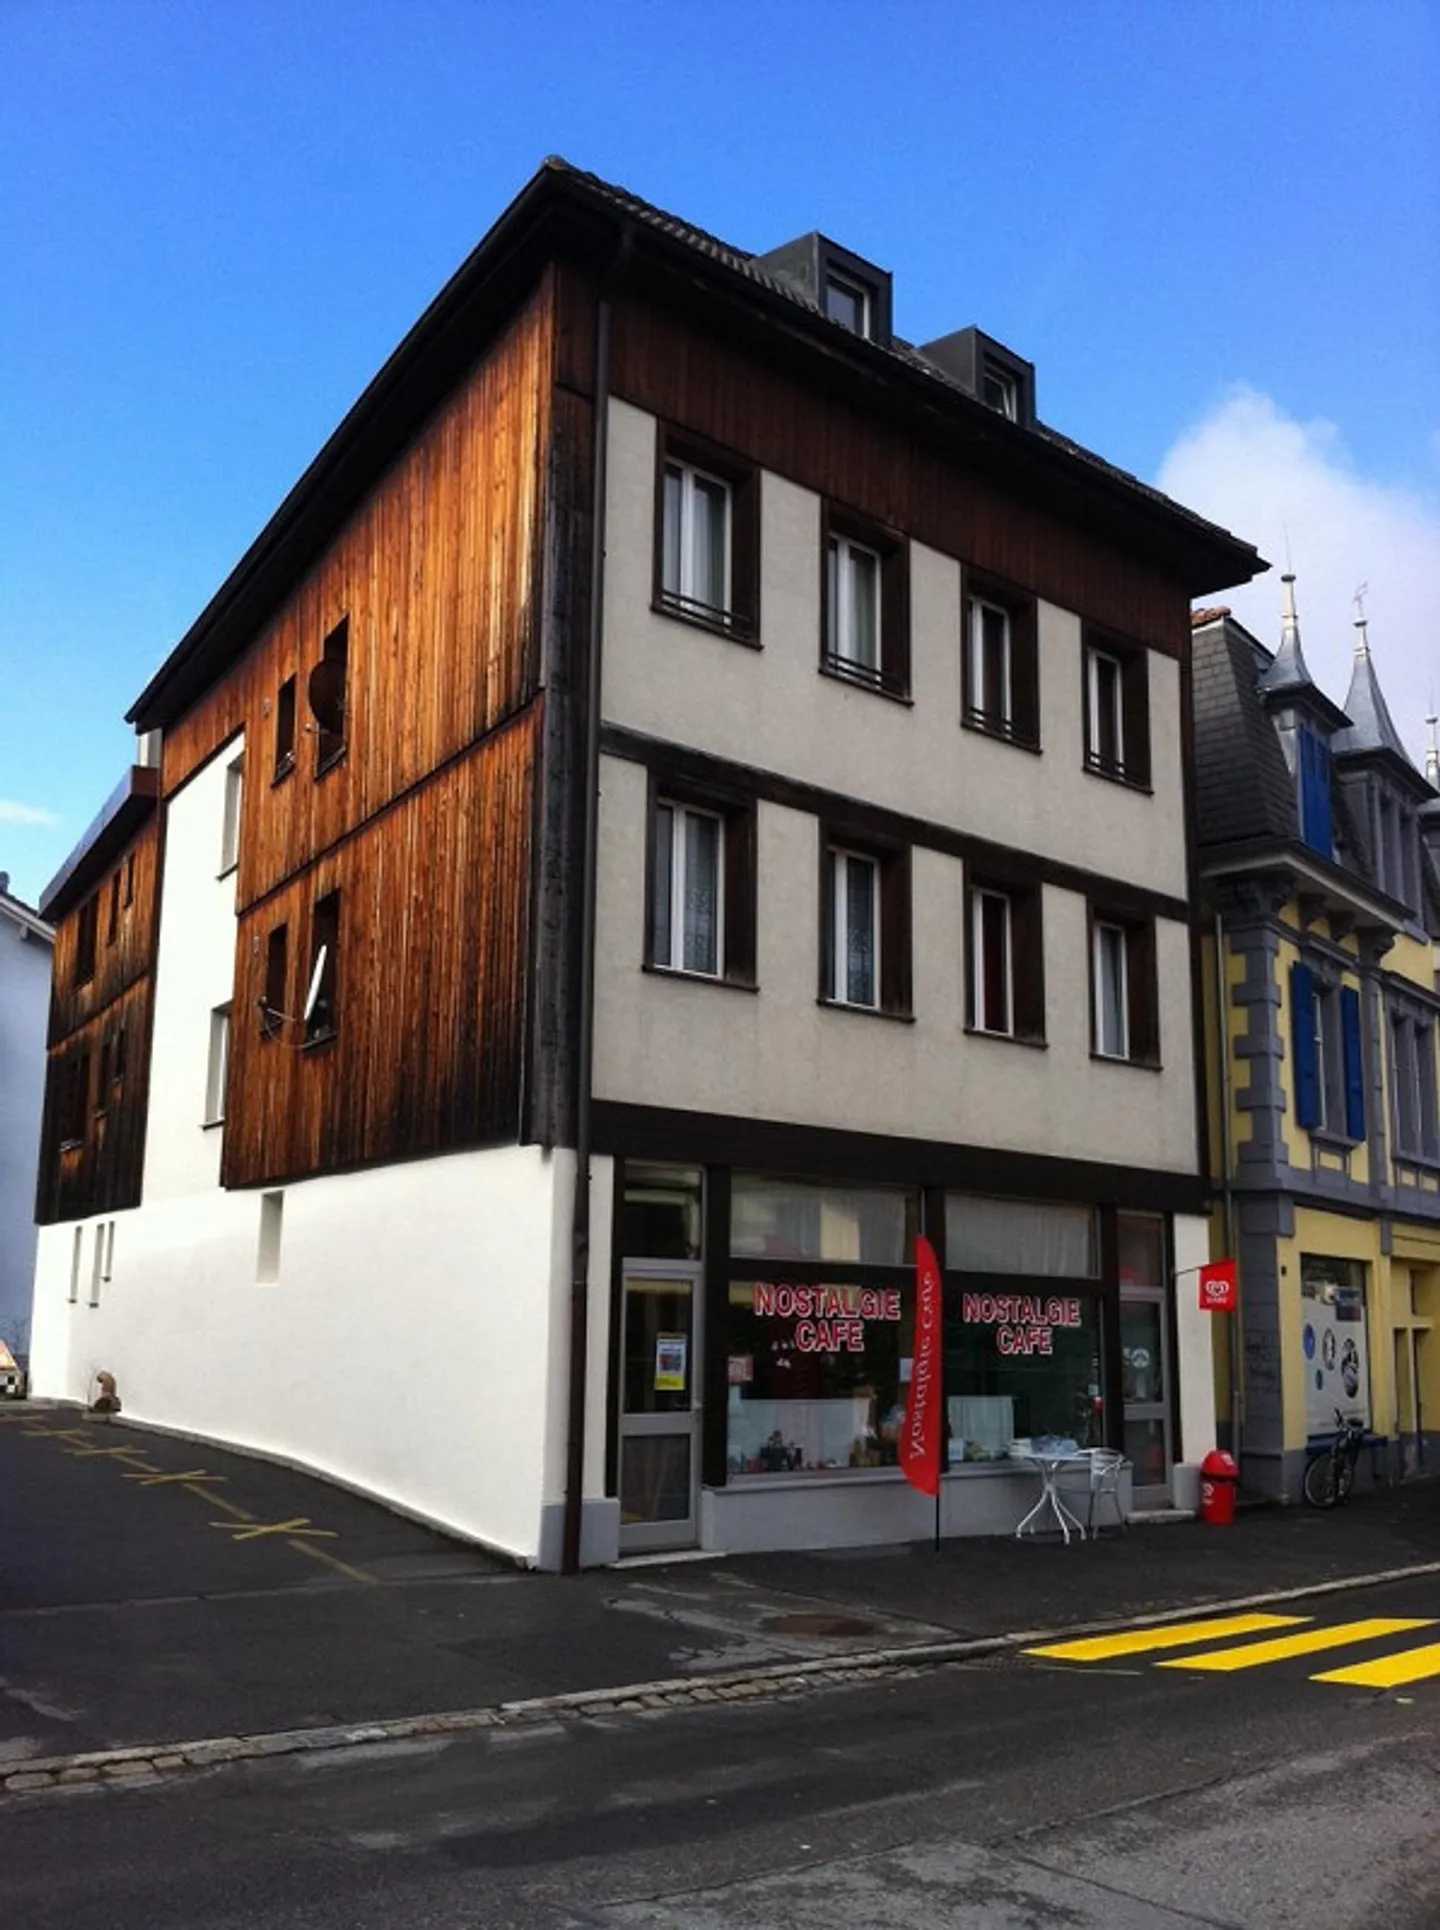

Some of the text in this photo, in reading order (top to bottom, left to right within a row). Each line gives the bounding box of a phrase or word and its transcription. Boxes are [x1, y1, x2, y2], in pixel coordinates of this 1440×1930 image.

[754, 1284, 901, 1320] NOSTALGIE
[962, 1293, 1082, 1327] NOSTALGIE
[795, 1319, 865, 1352] CAFE
[996, 1324, 1053, 1355] CAFE
